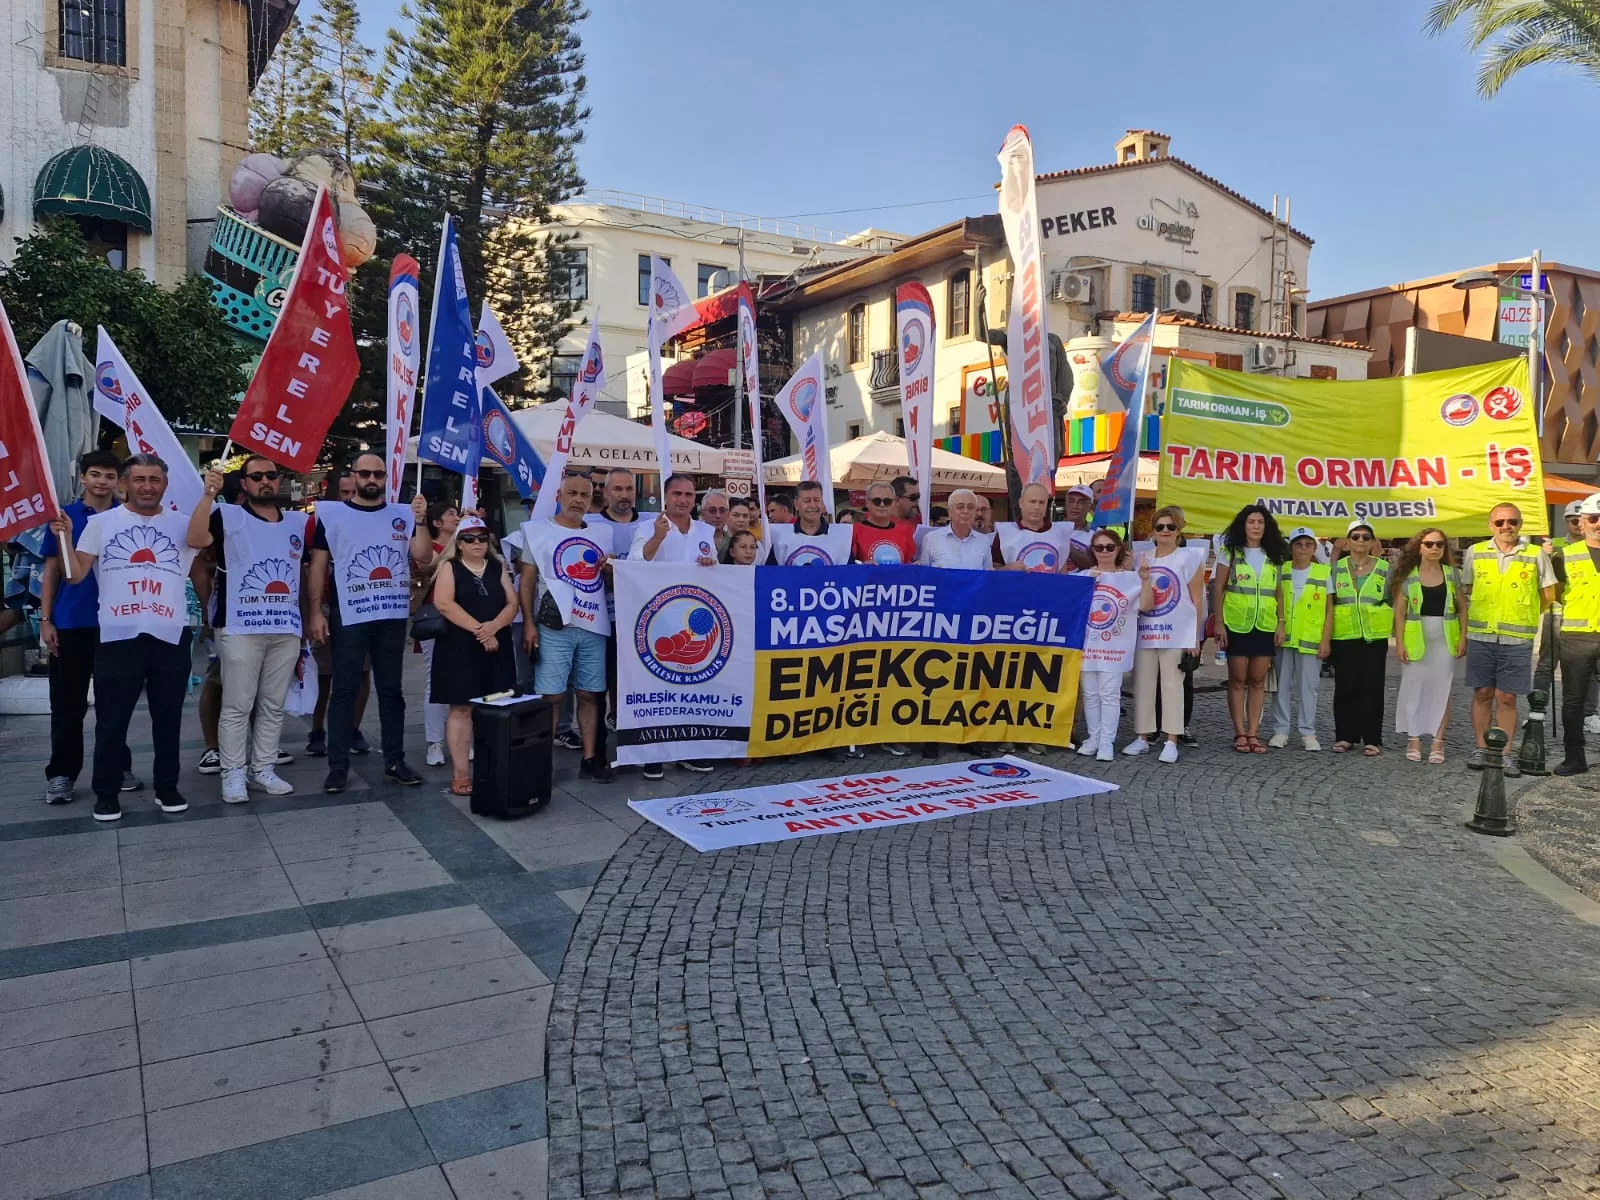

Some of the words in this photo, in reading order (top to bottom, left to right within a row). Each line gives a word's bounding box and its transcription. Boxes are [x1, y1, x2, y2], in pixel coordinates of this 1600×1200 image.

[1040, 206, 1118, 239] PEKER
[250, 422, 302, 458] SEN
[429, 436, 469, 465] SEN
[572, 446, 592, 458] LA
[599, 448, 692, 464] GELATIA
[1167, 445, 1285, 485] TARIM
[1297, 456, 1448, 487] ORMAN
[1488, 444, 1532, 487] İŞ
[884, 467, 900, 476] LA
[1256, 498, 1348, 517] ANTALYA
[1355, 498, 1436, 521] ŞUBESİ
[347, 583, 366, 593] TÜM
[771, 589, 795, 612] 8.
[799, 581, 937, 611] DÖNEMDE
[239, 595, 259, 604] TÜM
[348, 596, 371, 606] Emek
[573, 596, 600, 612] RLEŞİK
[237, 609, 263, 617] Emek
[572, 608, 596, 622] MU-İŞ
[770, 611, 961, 646] MASANIZIN
[964, 609, 1066, 644] DEĞİL
[643, 655, 682, 683] BİRLEŞİK
[626, 689, 677, 705] BİRLEŞİK
[680, 693, 720, 705] KAMU
[731, 693, 743, 708] İŞ
[633, 706, 734, 719] KONFEDERASYONU
[765, 694, 879, 742] DEDİĞİ
[892, 699, 1054, 730] OLACAK!
[638, 726, 728, 742] ANTALYA'DAYIZ
[769, 775, 976, 807] YEREL-SEN
[816, 775, 901, 791] TÜM
[699, 817, 748, 828] Tüm
[751, 810, 804, 821] Yerel
[807, 800, 885, 813] Yönetim
[785, 802, 948, 833] ANTALYA
[945, 790, 1040, 810] ŞUBE
